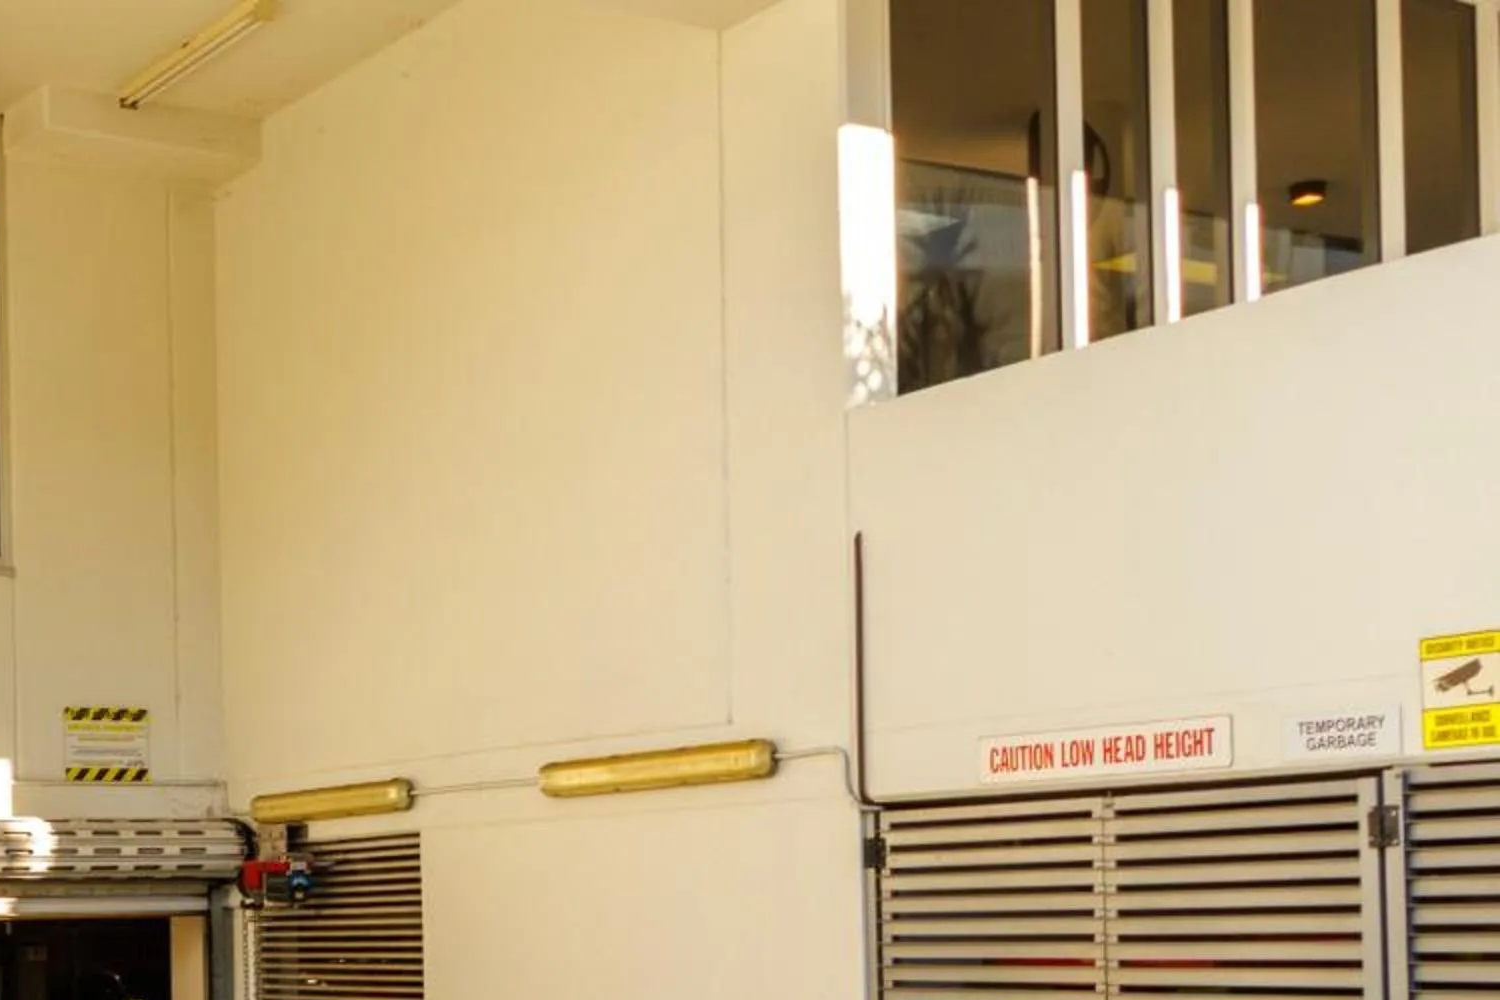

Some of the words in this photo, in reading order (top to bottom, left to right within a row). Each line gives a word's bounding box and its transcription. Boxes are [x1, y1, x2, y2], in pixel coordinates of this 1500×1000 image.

[1297, 714, 1385, 736] TEMPORARY
[990, 743, 1054, 774] CAUTION
[1060, 740, 1094, 768] LOW
[1103, 735, 1146, 764] HEAD
[1154, 728, 1215, 761] HEIGHT
[1306, 731, 1377, 751] GARBAGE
